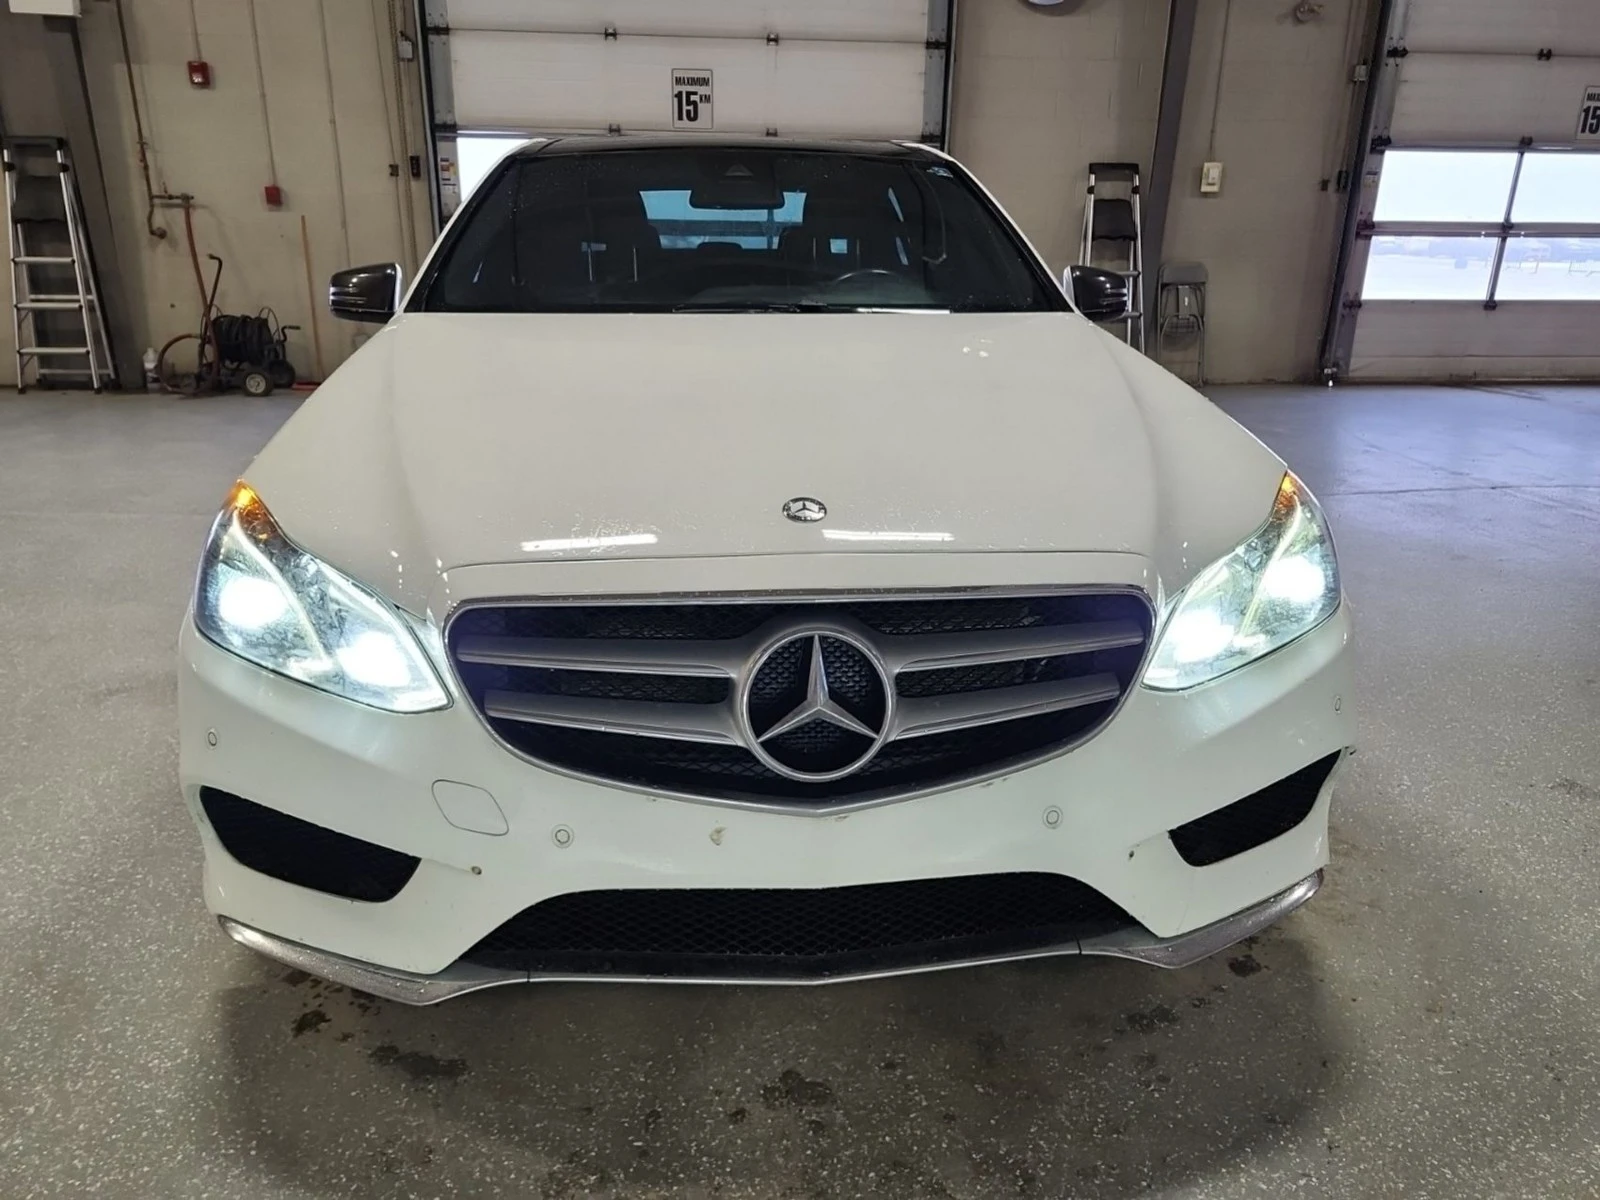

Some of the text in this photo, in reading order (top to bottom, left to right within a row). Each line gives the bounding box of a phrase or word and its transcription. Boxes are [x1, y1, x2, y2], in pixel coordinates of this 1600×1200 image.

[675, 76, 710, 87] MAXIMUM
[674, 90, 711, 122] 15 KM
[1580, 105, 1600, 135] 15
